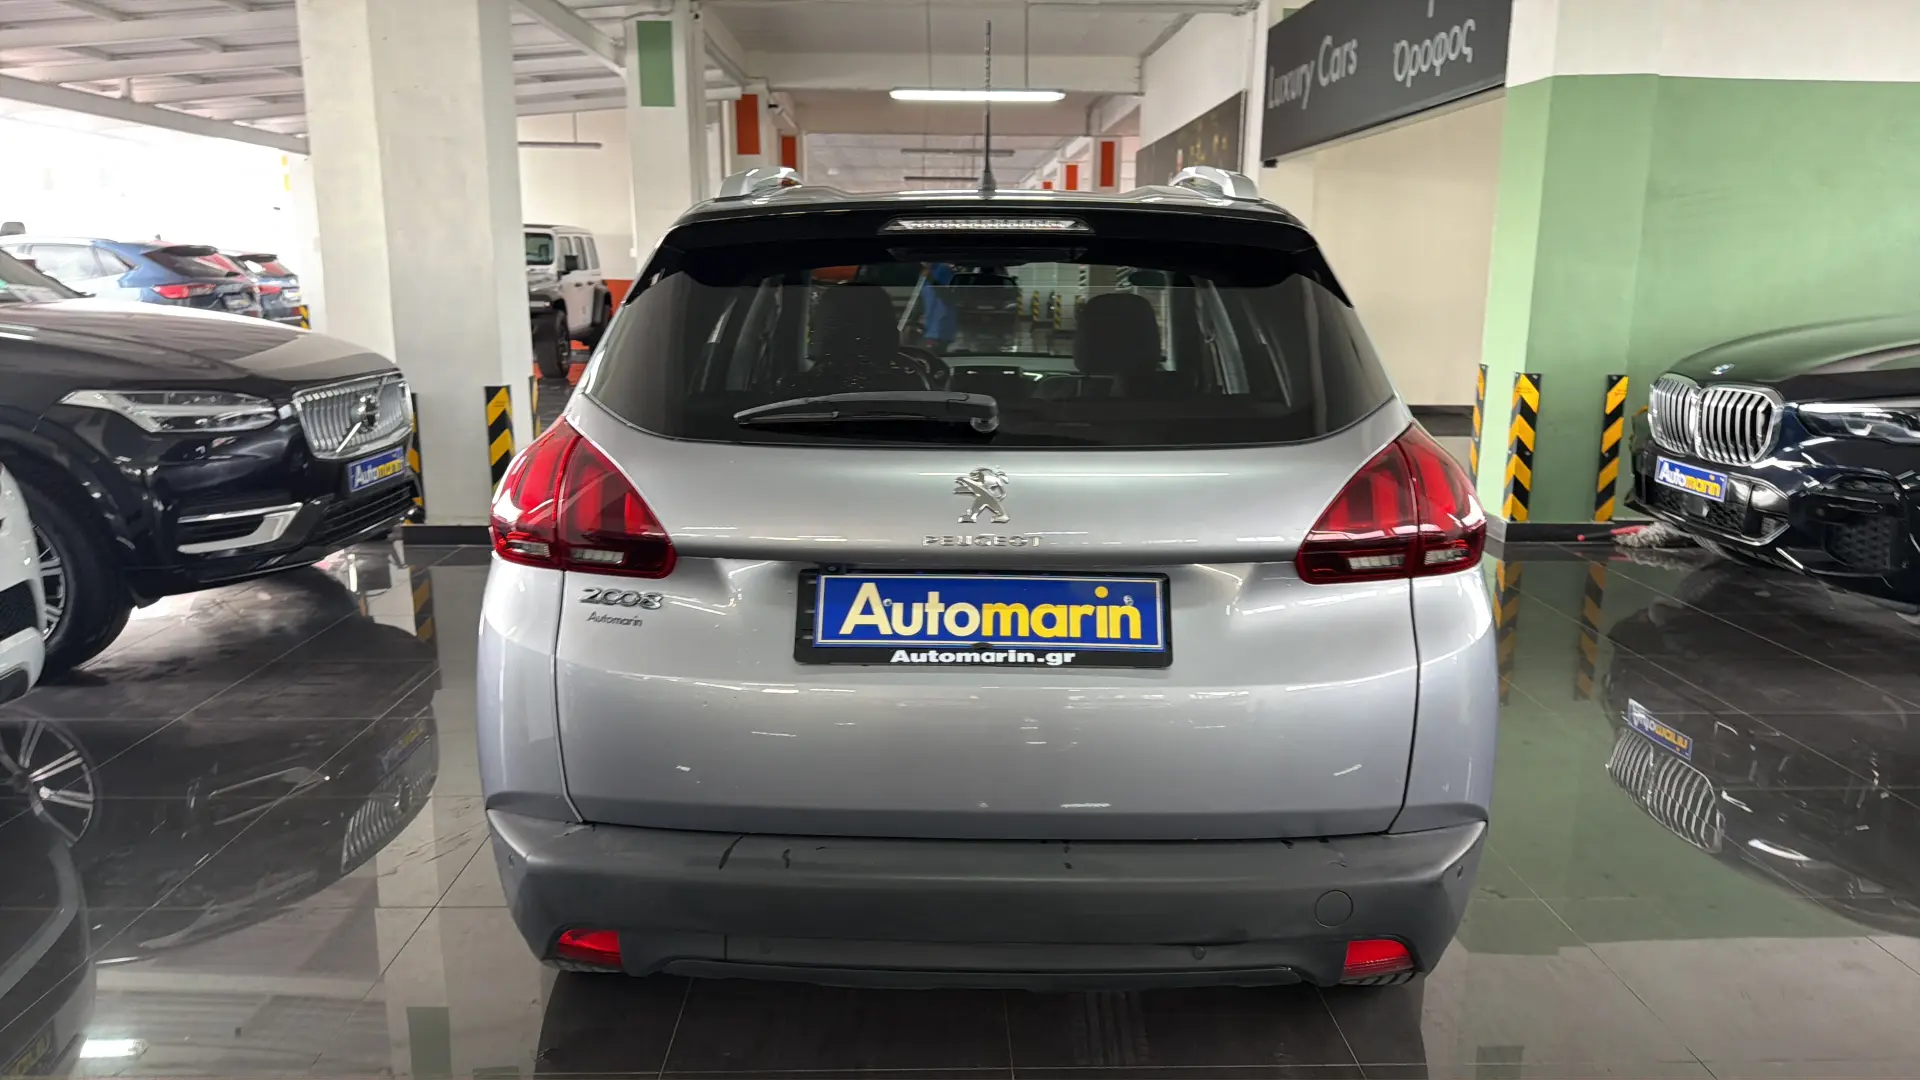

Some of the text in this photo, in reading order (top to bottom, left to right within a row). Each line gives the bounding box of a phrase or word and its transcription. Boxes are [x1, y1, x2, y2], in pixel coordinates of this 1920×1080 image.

[1267, 35, 1358, 110] Luxury Cars
[1659, 461, 1721, 497] Automarin
[922, 535, 1043, 547] PEUGEOT
[580, 587, 664, 610] 2008
[586, 611, 643, 627] Automarin
[839, 582, 1142, 639] Automarin
[890, 649, 1076, 666] Automarin.gr
